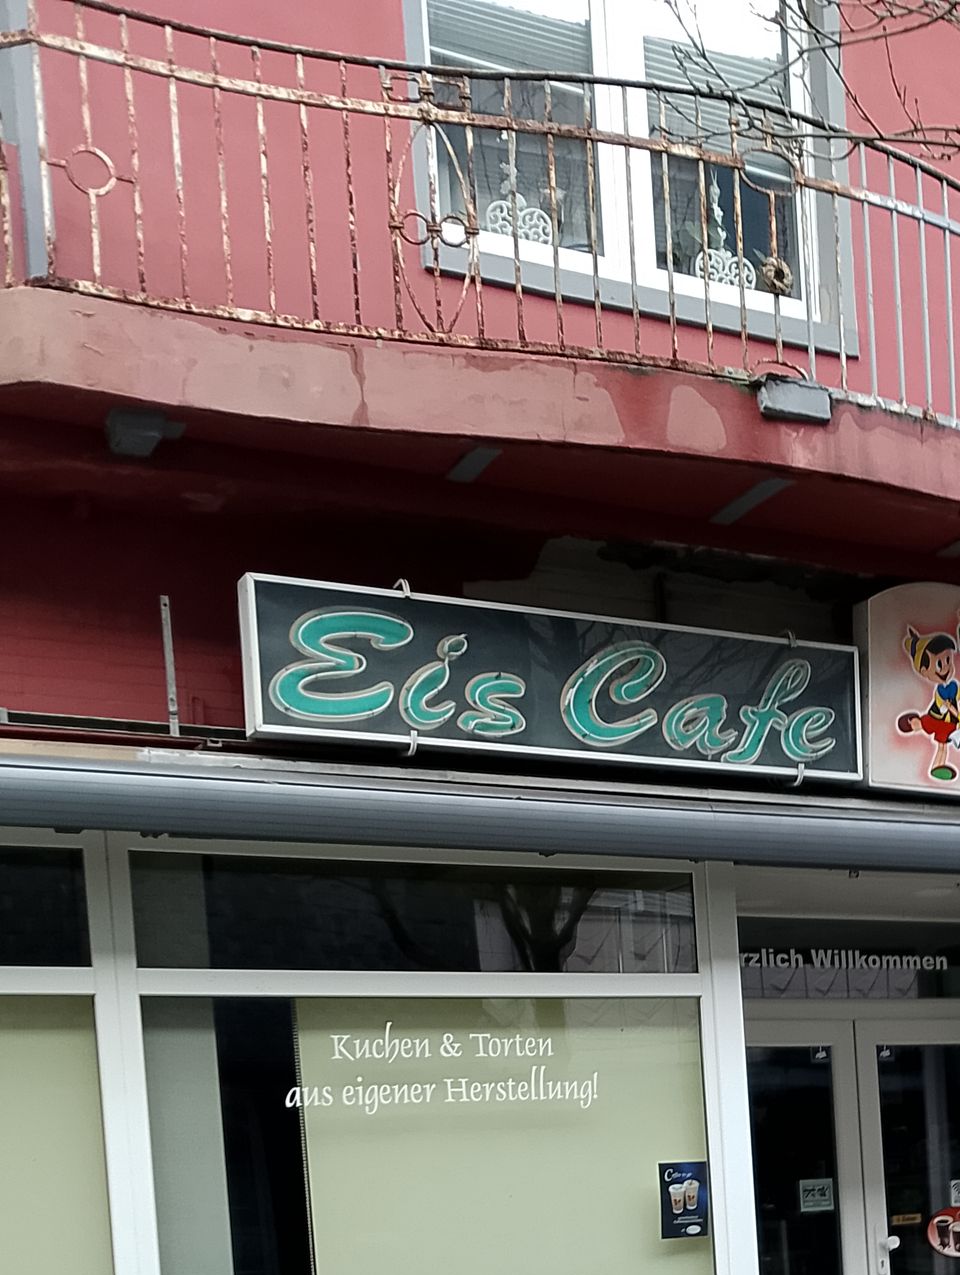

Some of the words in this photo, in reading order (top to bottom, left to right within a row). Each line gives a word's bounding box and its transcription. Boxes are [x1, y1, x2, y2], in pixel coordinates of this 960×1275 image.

[268, 605, 526, 735] Eis
[561, 639, 837, 764] Cafe
[810, 949, 949, 970] Willkommen
[329, 1021, 432, 1063] Kuchen
[439, 1032, 463, 1058] &
[469, 1032, 554, 1058] Torten
[284, 1083, 334, 1109] aus
[341, 1076, 436, 1115] eigener
[443, 1065, 599, 1109] Herstellung!
